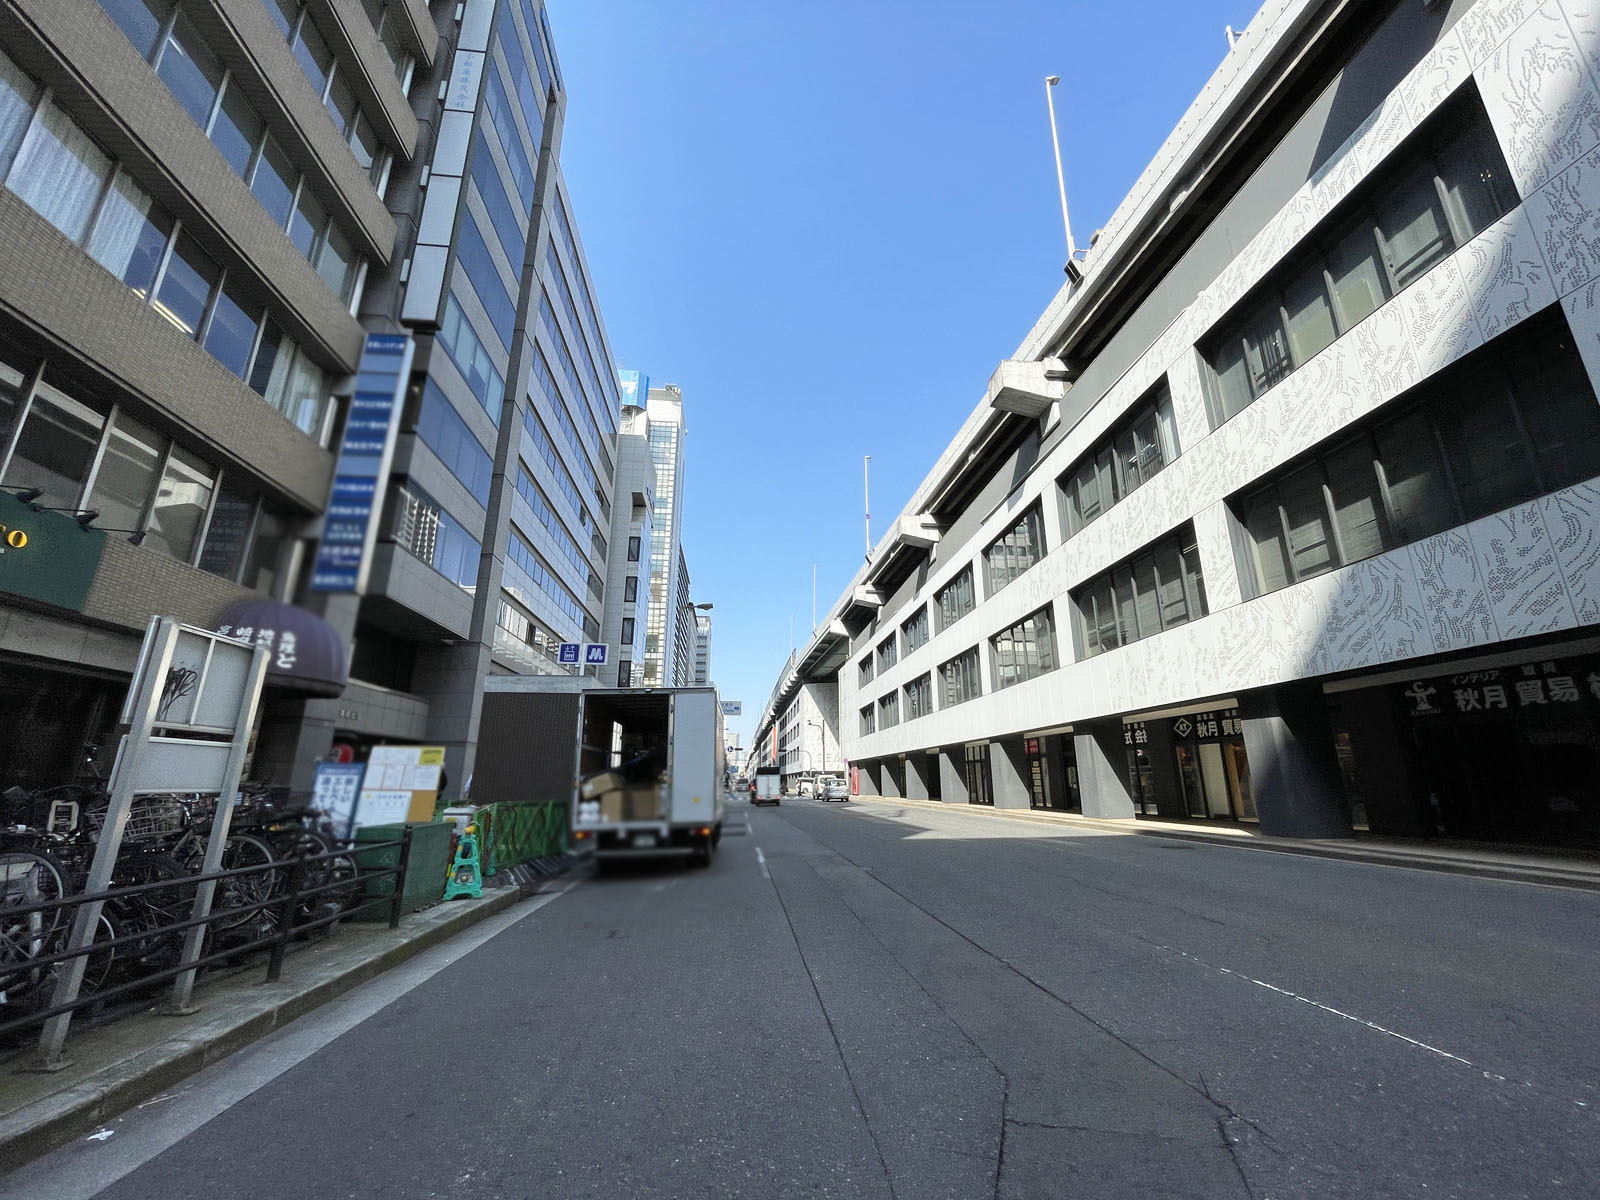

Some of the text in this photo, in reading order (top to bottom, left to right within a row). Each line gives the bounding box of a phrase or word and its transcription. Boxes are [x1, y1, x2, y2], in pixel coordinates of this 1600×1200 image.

[1450, 670, 1500, 685] インテリア
